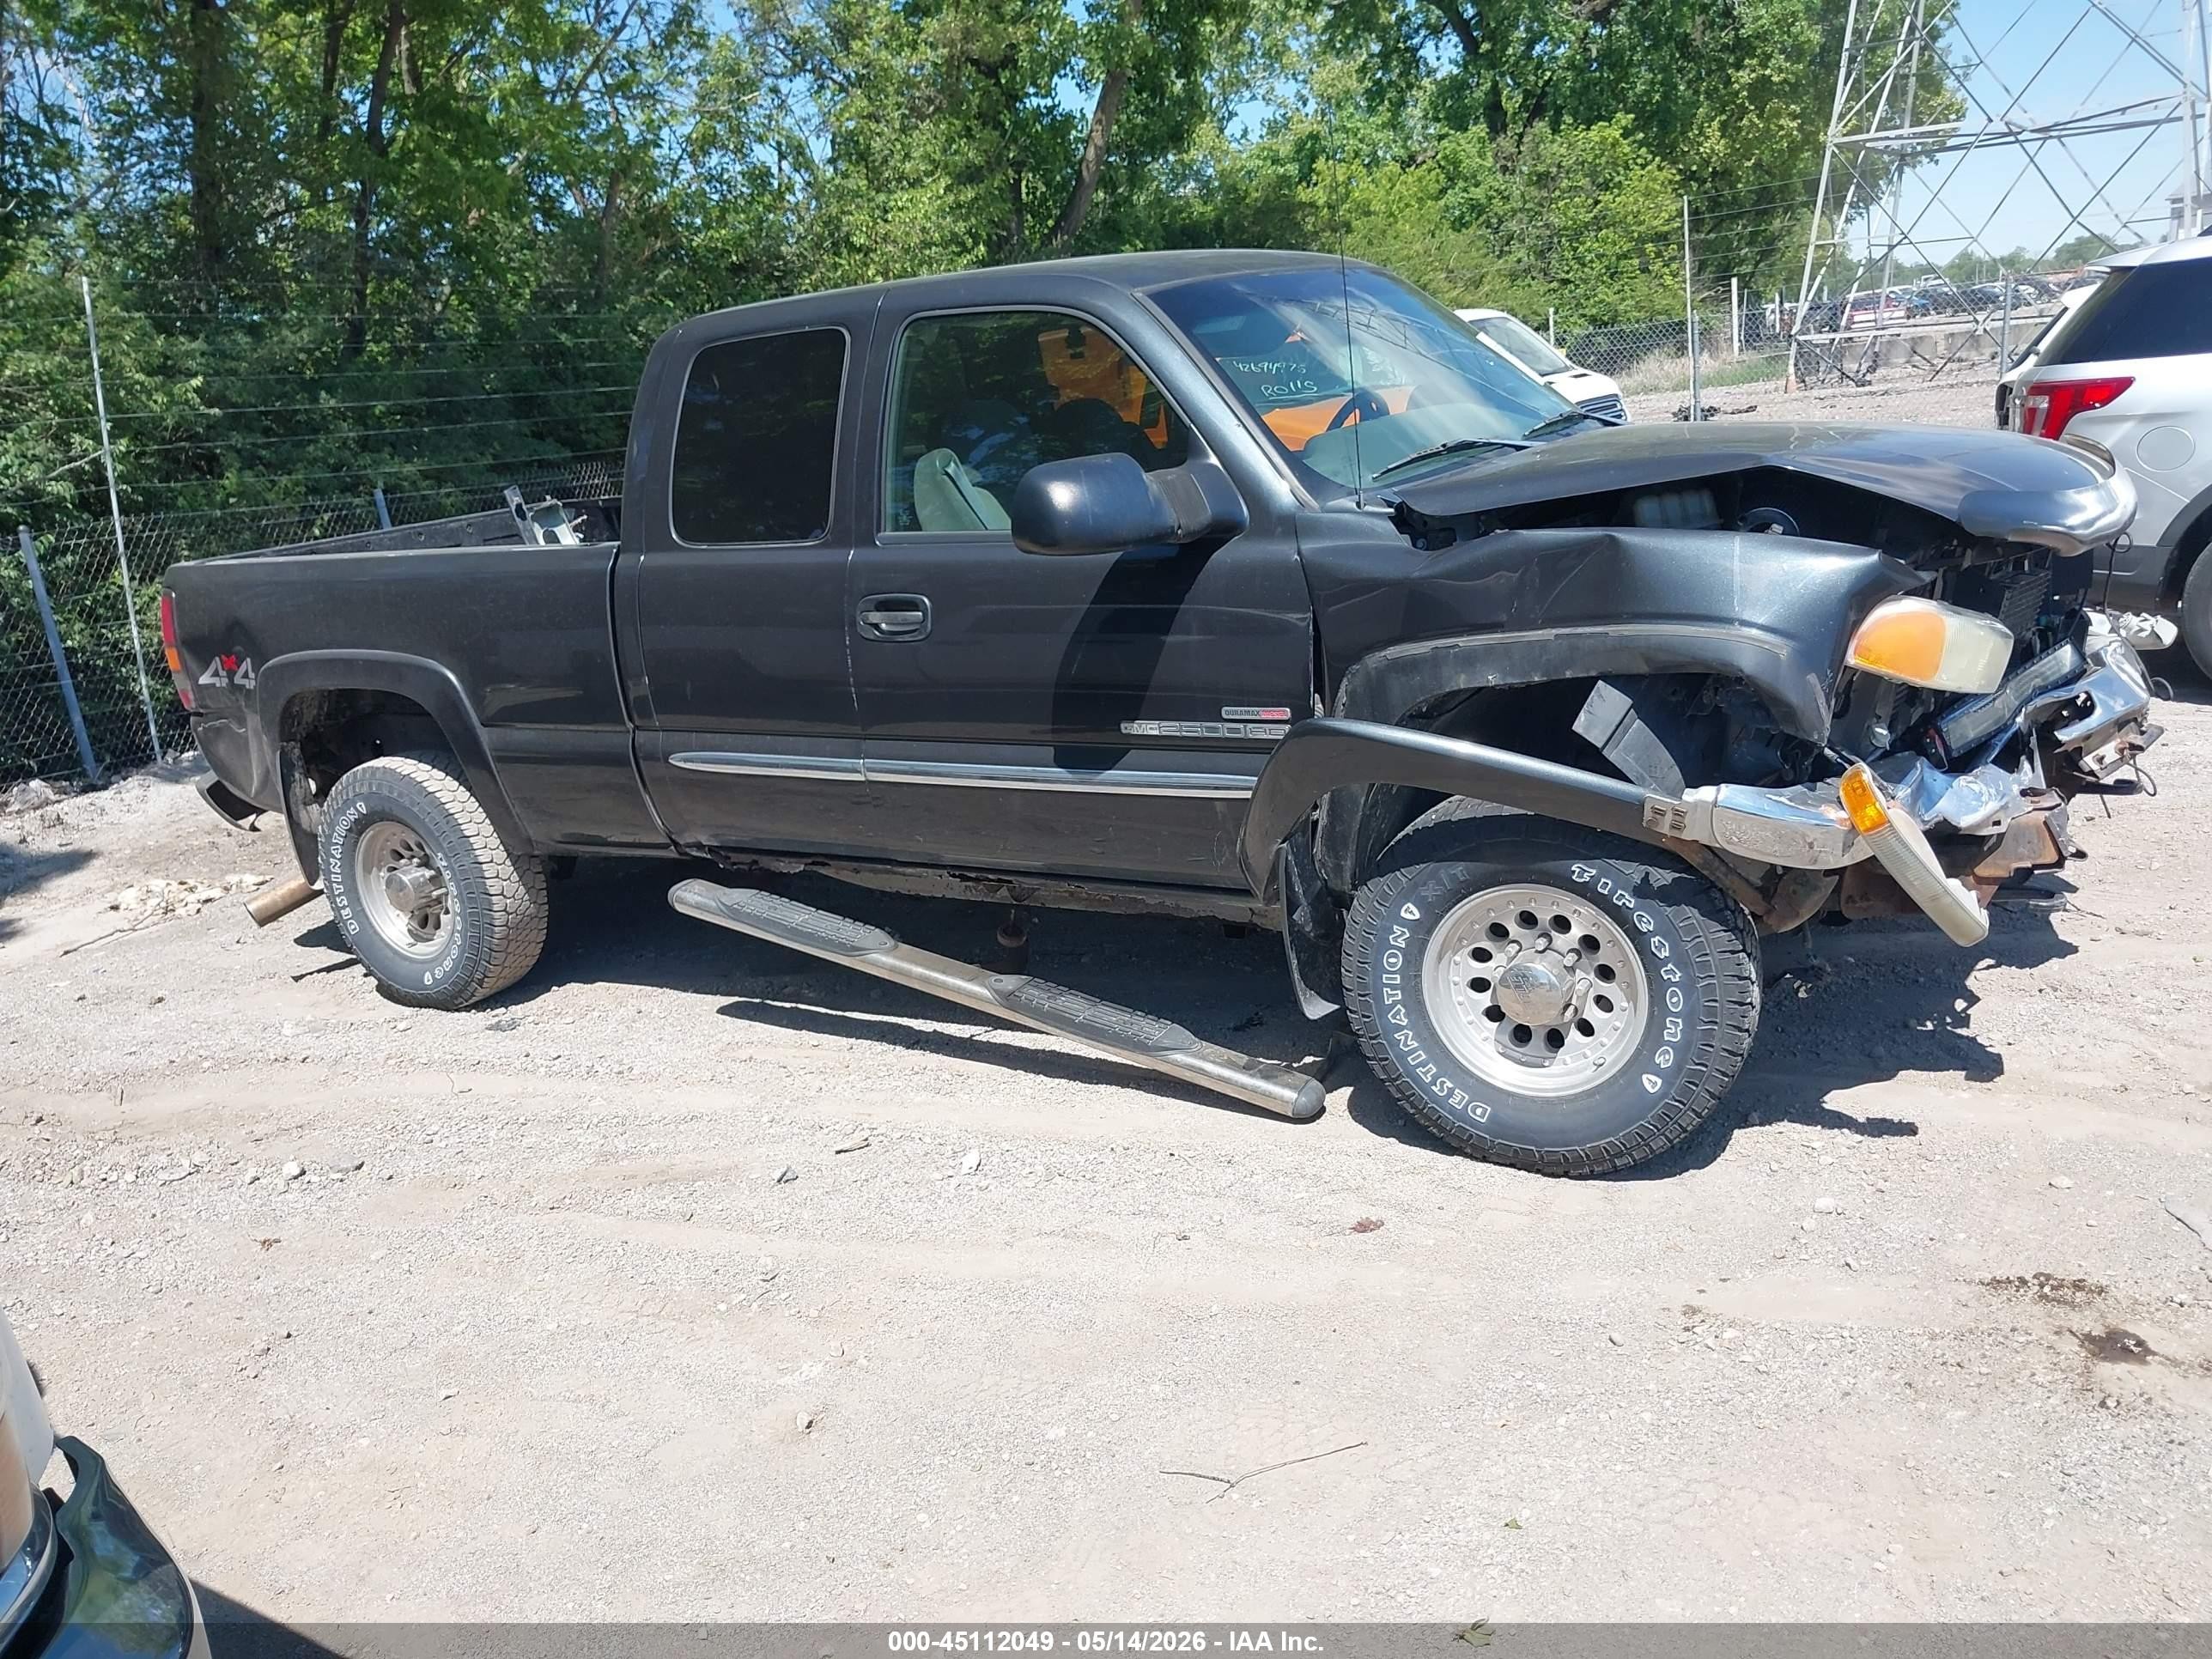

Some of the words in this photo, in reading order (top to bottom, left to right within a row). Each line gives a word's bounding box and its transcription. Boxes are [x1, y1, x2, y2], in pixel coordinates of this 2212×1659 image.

[1121, 720, 1159, 735] GMC
[1224, 708, 1260, 718] DURAMAX
[329, 806, 360, 935] DESTINATION
[1382, 923, 1492, 1123] DESTINATION
